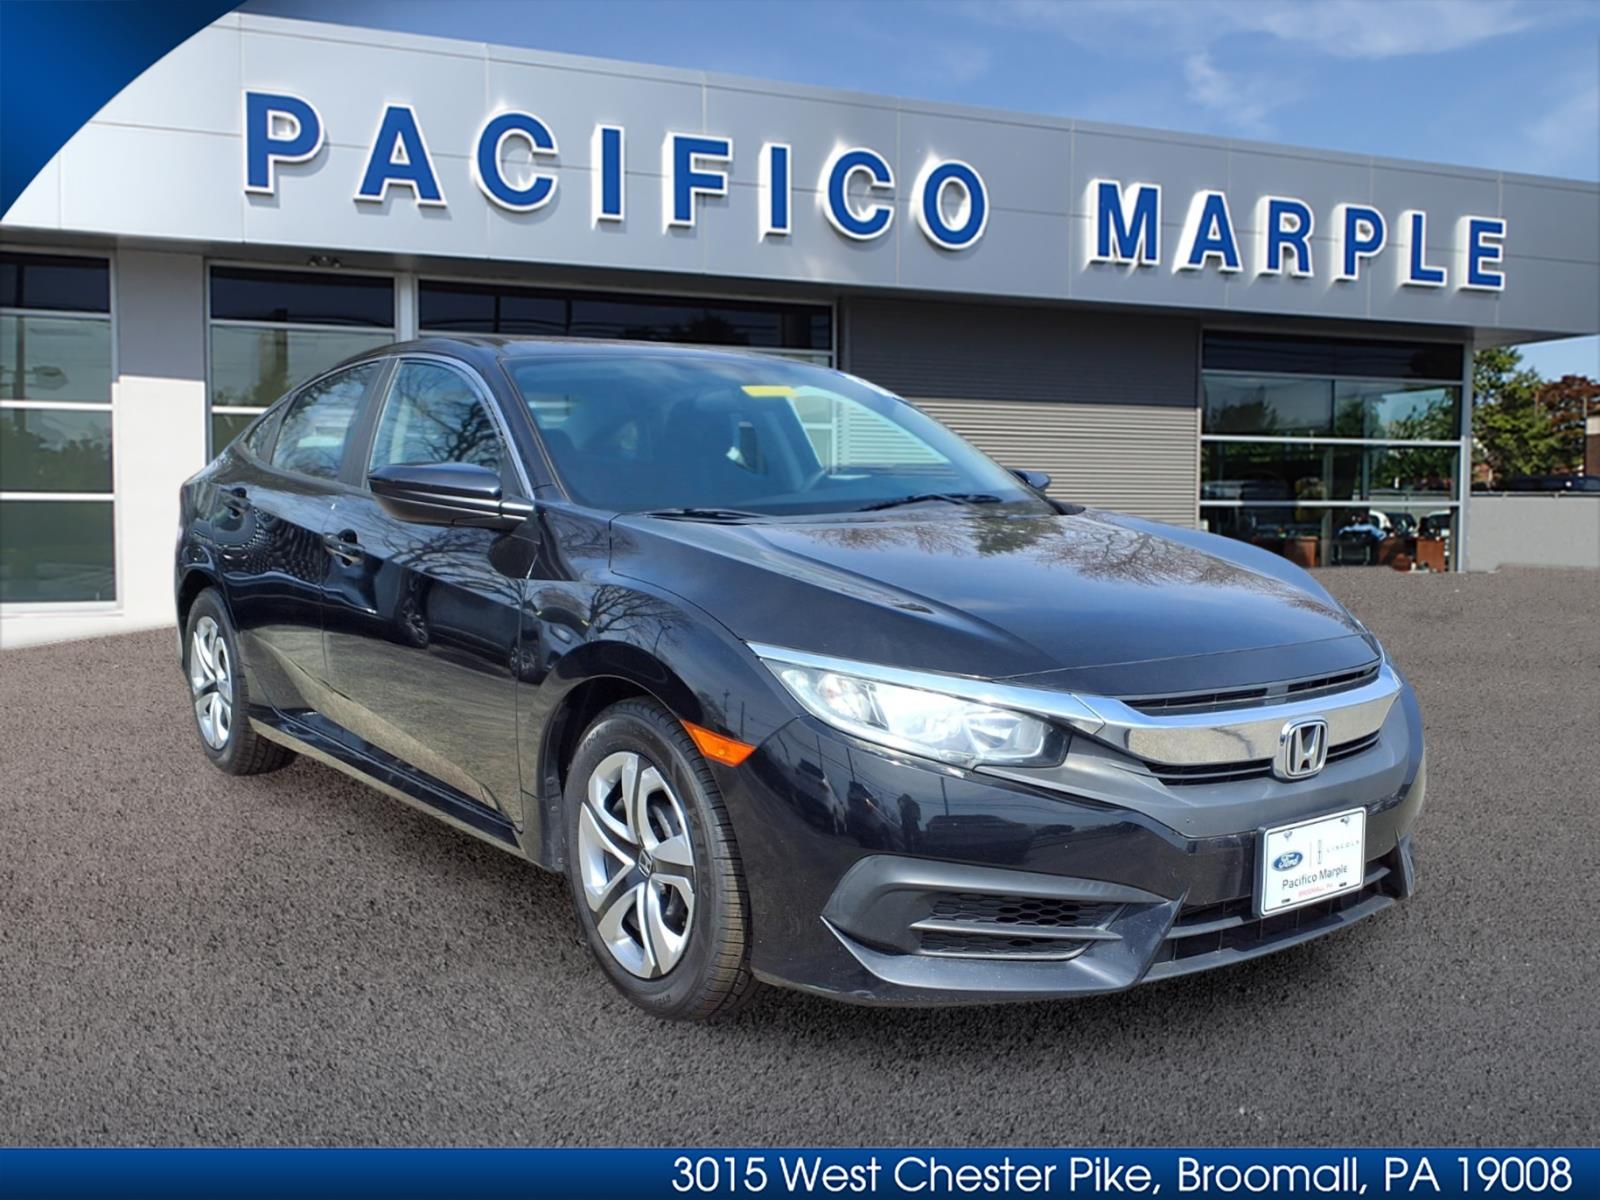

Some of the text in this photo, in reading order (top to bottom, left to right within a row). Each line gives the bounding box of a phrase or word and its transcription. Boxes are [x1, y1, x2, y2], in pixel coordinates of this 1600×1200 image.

[243, 90, 1506, 291] PACIFICO MARPLE
[1282, 873, 1318, 889] Pacifico
[1319, 864, 1348, 879] Marple
